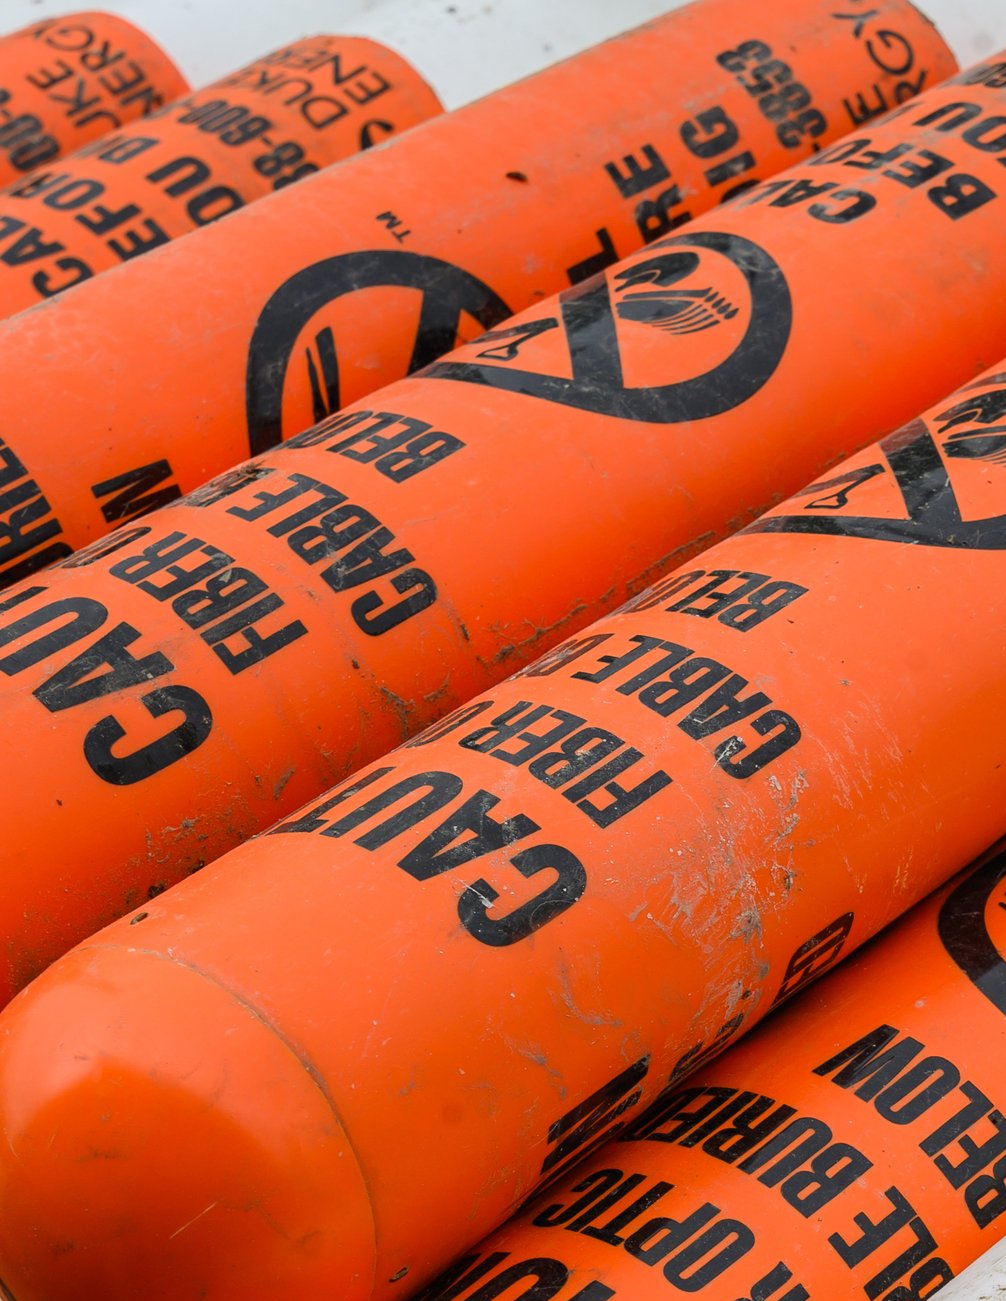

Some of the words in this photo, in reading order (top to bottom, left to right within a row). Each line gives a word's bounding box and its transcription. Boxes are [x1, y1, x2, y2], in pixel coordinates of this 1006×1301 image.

[146, 157, 246, 228] OU
[808, 138, 998, 221] BEFO
[283, 411, 467, 483] BELO
[109, 531, 309, 675] FIBER
[225, 473, 438, 637] CABLE
[615, 569, 809, 632] BELO
[458, 700, 673, 829] FIBER
[571, 634, 801, 779] CABLE
[264, 766, 588, 948] CAUT
[532, 1168, 755, 1293] OPTIC
